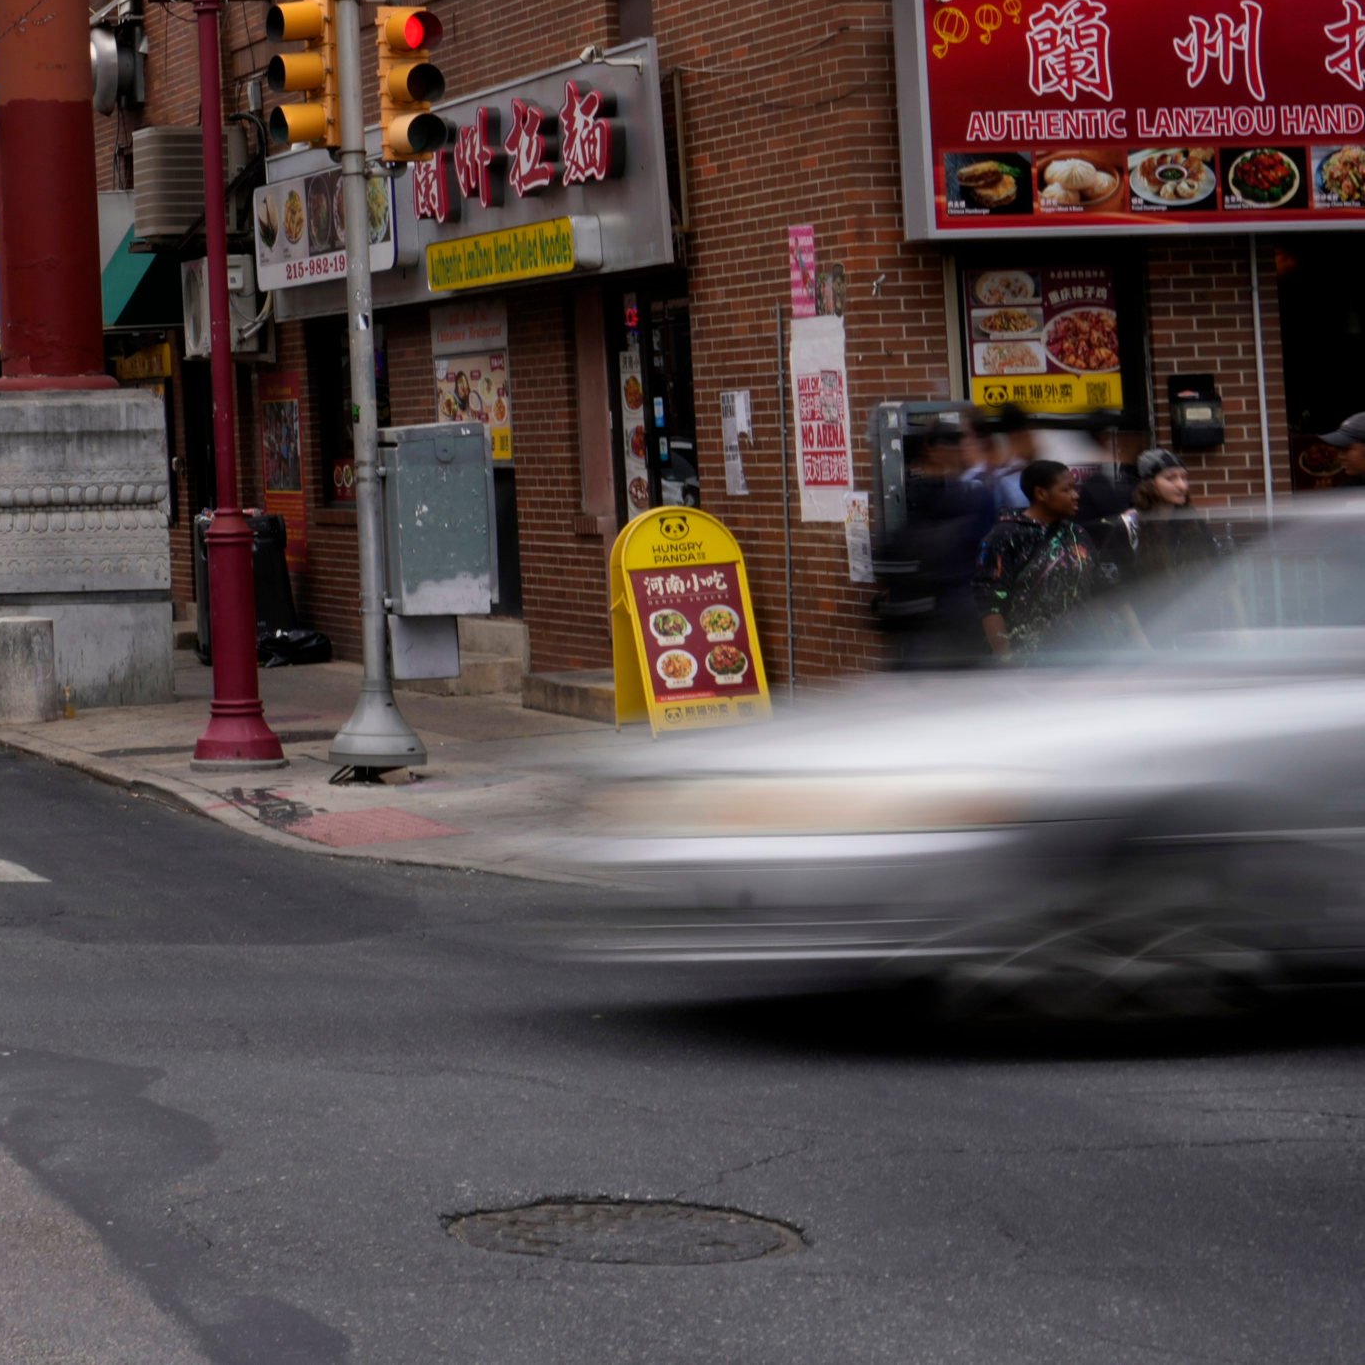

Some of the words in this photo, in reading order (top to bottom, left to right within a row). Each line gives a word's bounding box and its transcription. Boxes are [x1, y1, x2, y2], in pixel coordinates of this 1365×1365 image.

[967, 108, 1127, 141] AUTHENTIC
[1137, 105, 1276, 138] LANZHOU
[1281, 104, 1365, 136] HAND
[285, 253, 347, 281] 215-982-19
[430, 246, 463, 286] Authentic
[539, 223, 571, 269] Noodles
[1013, 383, 1074, 400] 熊猫外卖
[801, 424, 816, 449] NO
[817, 421, 846, 450] ARENA
[651, 541, 704, 554] HUNGRY
[654, 553, 697, 565] PANDA
[644, 570, 728, 597] 河南小吃
